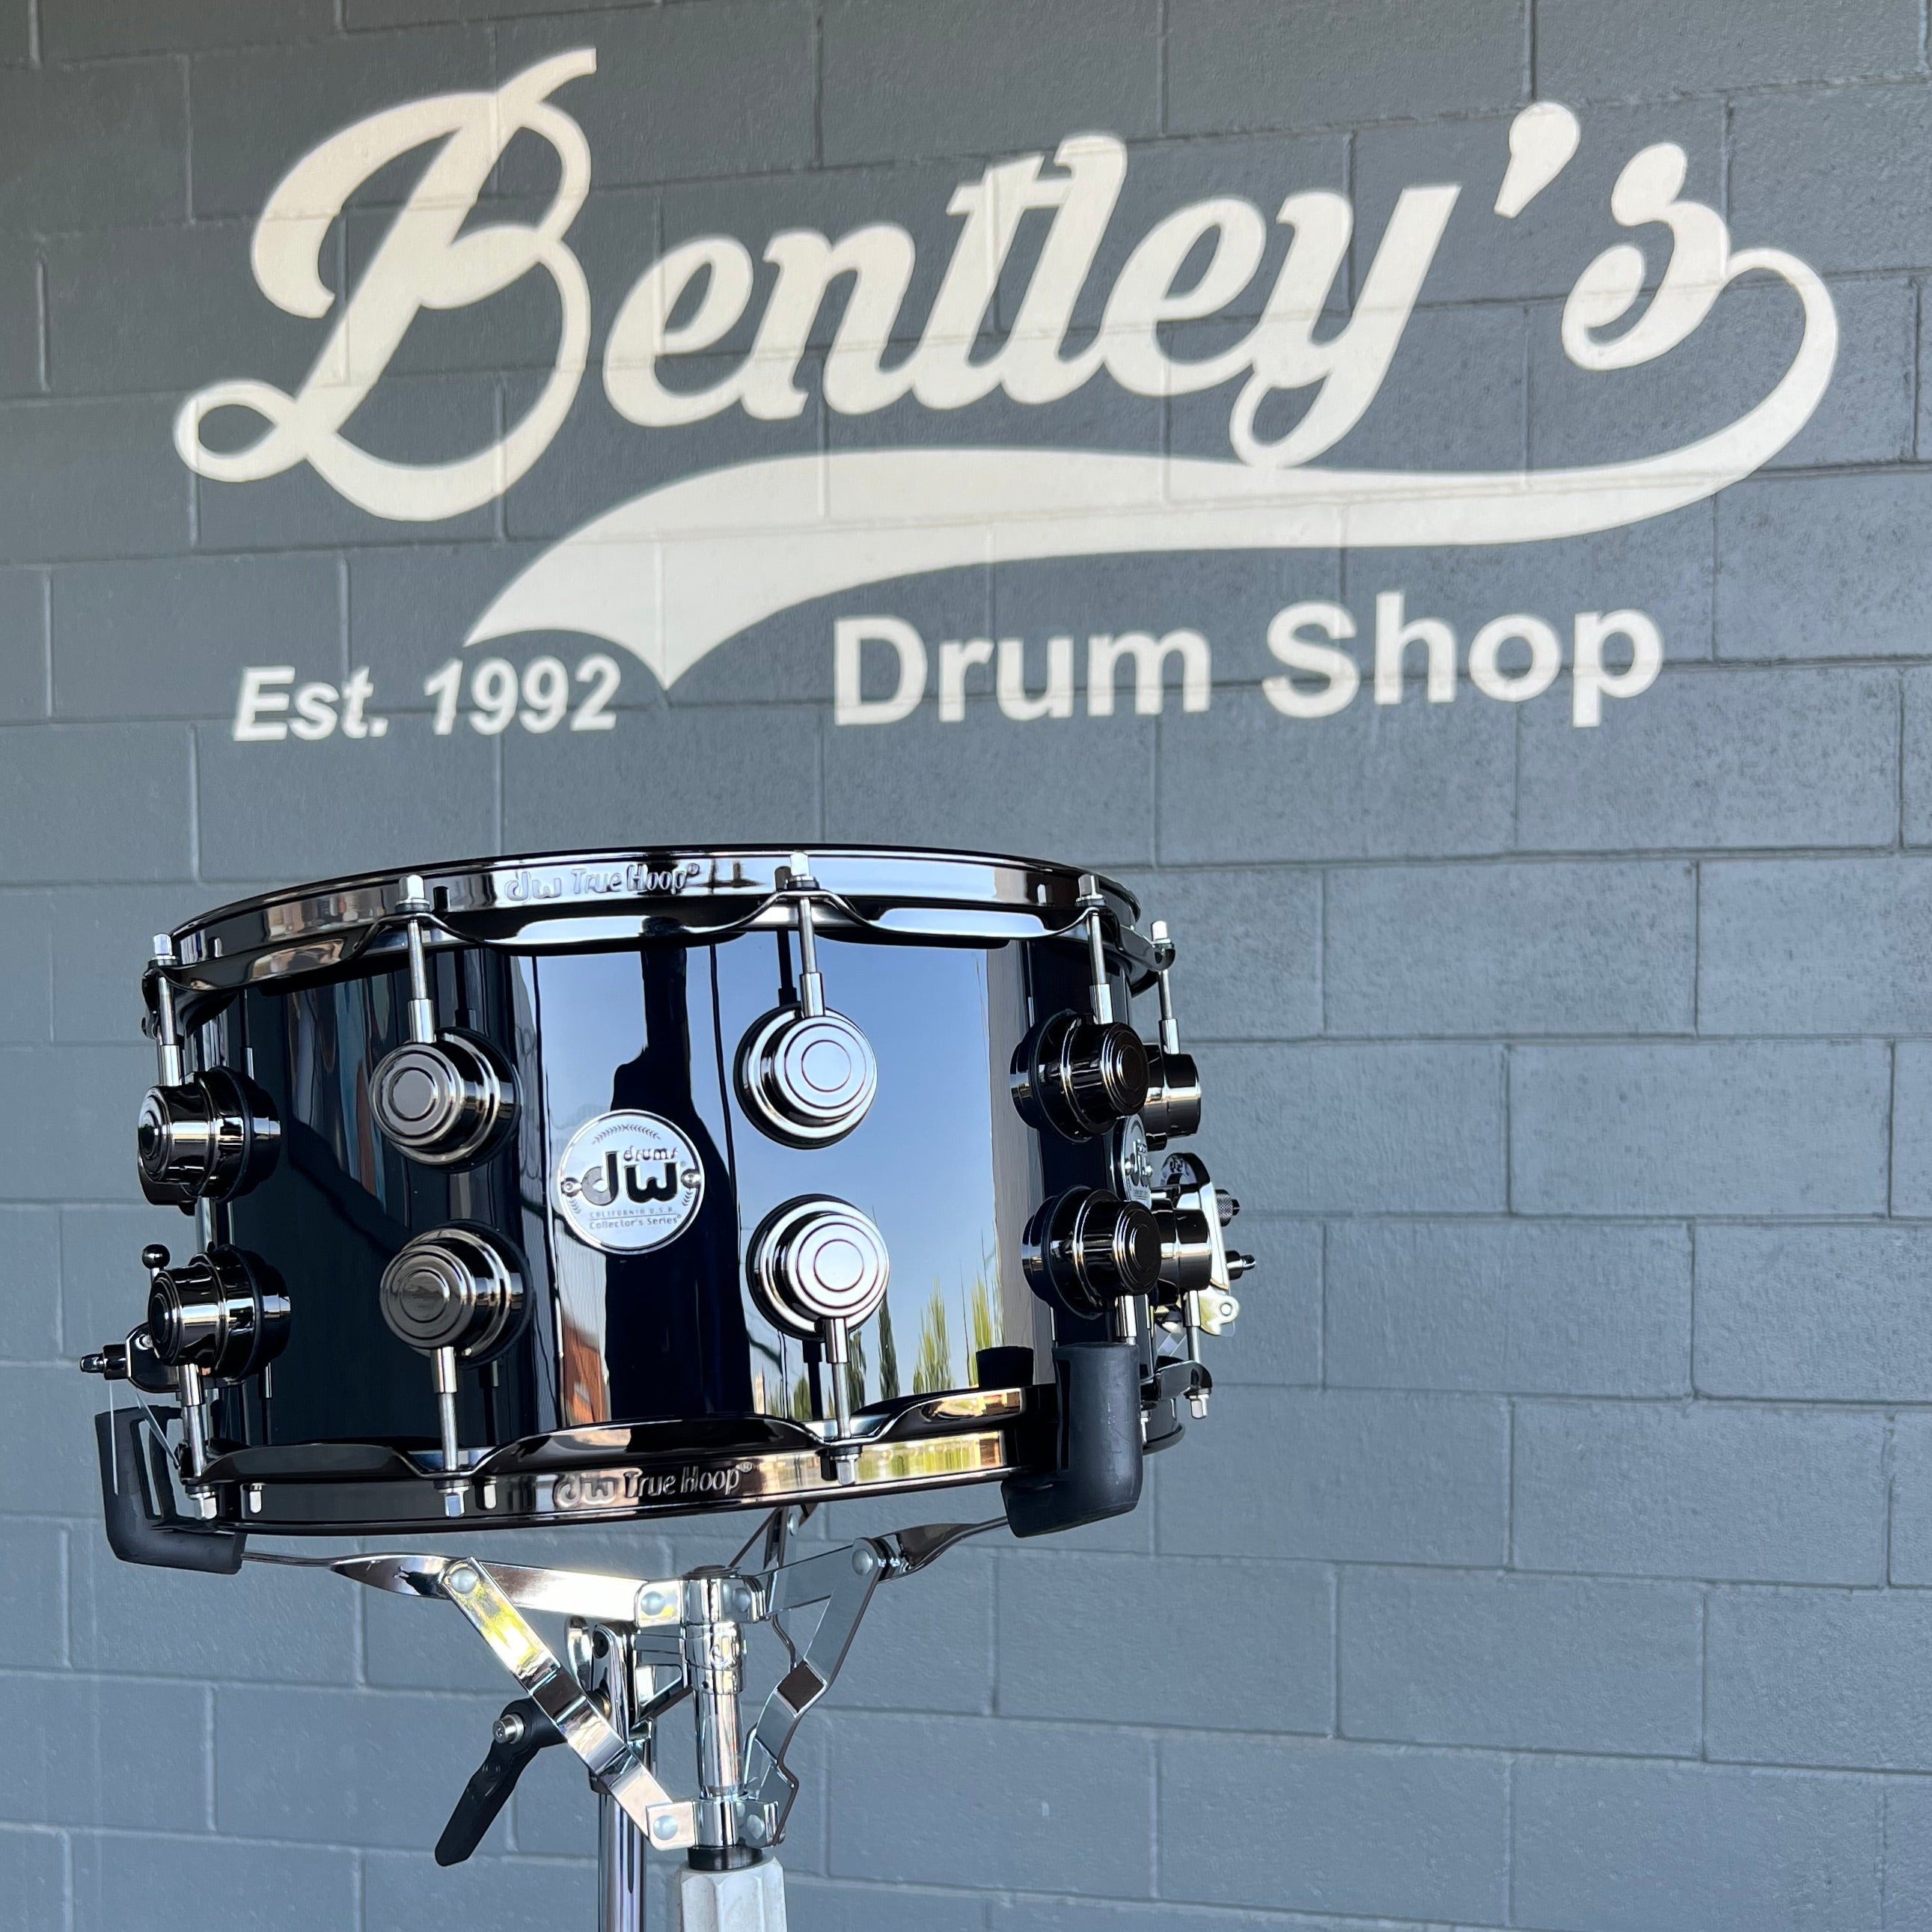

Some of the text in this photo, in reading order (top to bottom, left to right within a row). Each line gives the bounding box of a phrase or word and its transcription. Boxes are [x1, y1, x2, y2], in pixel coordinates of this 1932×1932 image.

[174, 47, 1840, 522] Bentley's
[834, 590, 1665, 730] Drum Shop
[233, 654, 622, 742] Est. 1992
[504, 870, 562, 902] dw
[570, 868, 622, 894] True
[581, 1150, 679, 1207] dw
[589, 1219, 644, 1229] Collector's
[623, 1467, 676, 1498] True
